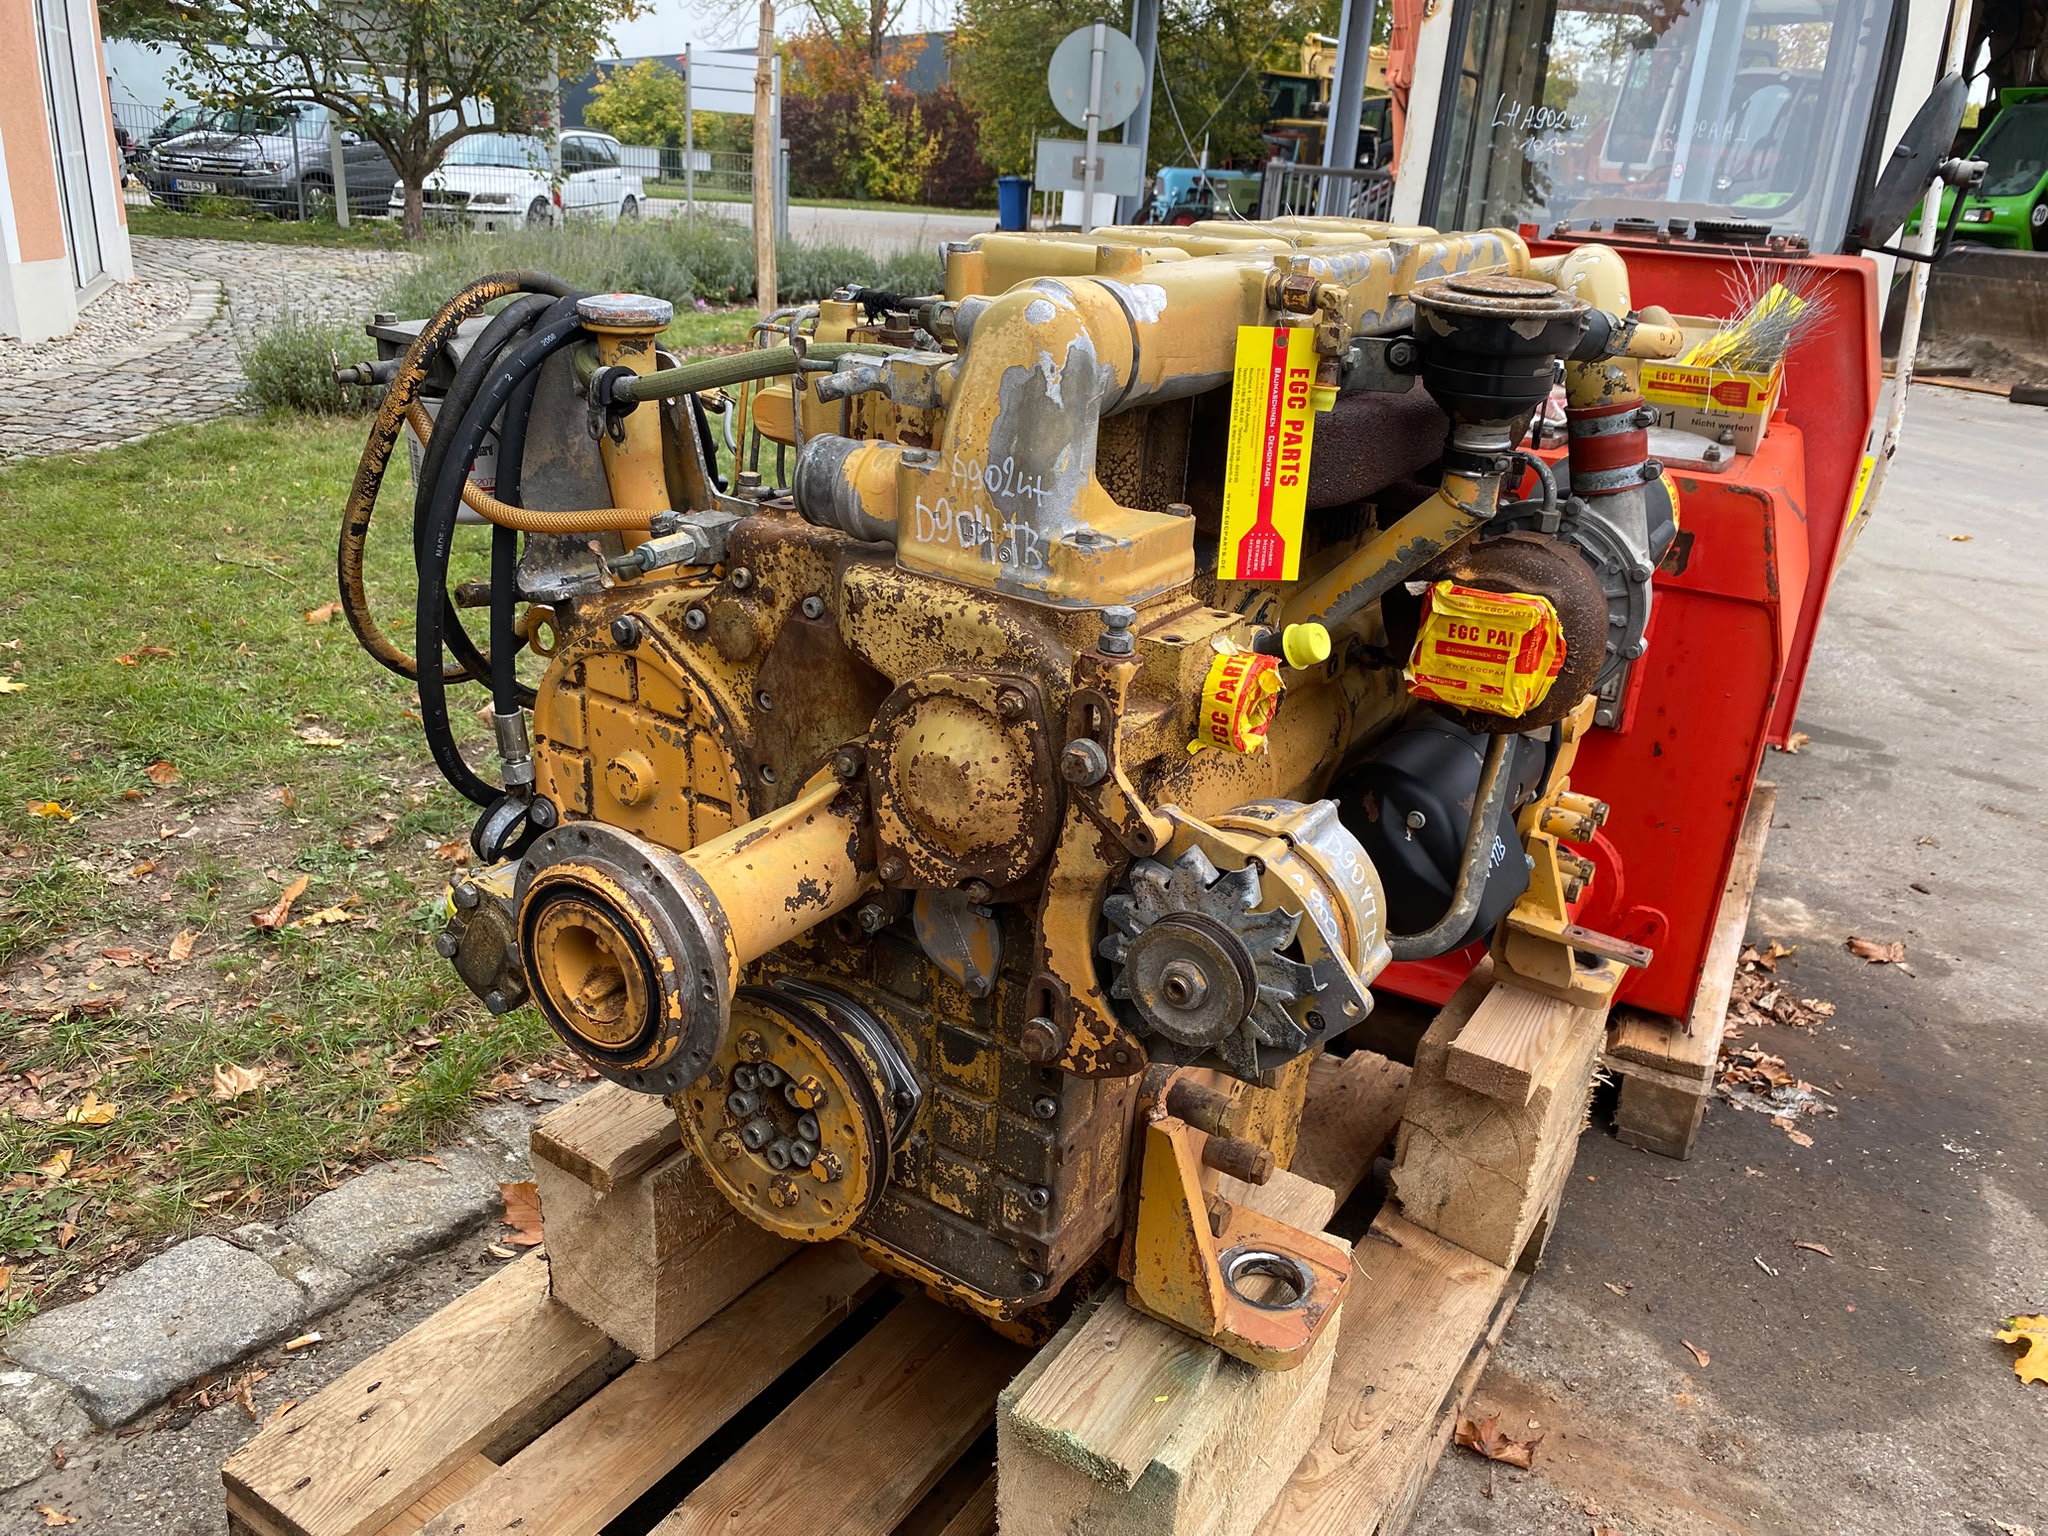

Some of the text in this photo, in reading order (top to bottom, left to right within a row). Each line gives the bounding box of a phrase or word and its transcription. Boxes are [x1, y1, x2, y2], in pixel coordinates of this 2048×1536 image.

[1656, 371, 1675, 382] EGC
[1264, 367, 1281, 487] BAUMASCHINEN DEMONTAGEN
[1280, 368, 1310, 487] EGC PARTS
[1692, 418, 1754, 433] Nicht werfen!
[1447, 623, 1480, 642] EGC
[1211, 711, 1231, 747] EGC
